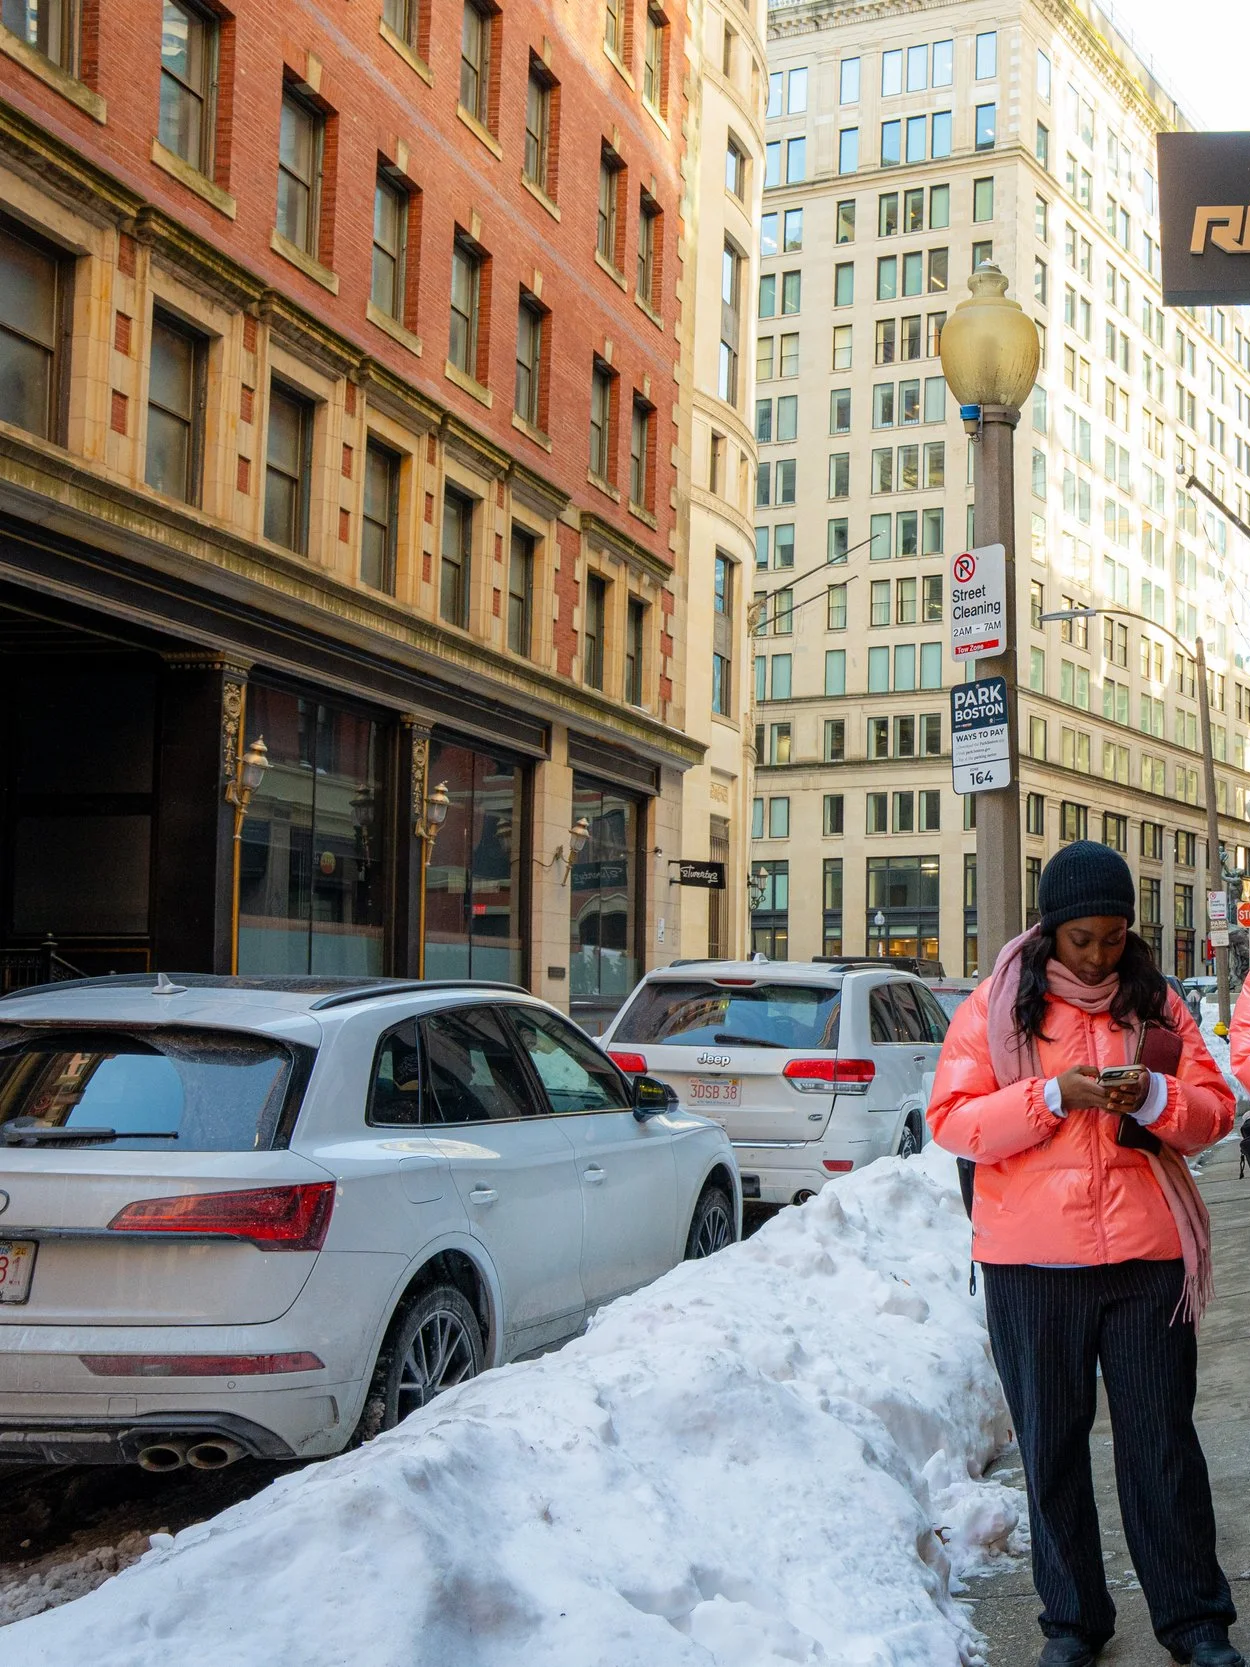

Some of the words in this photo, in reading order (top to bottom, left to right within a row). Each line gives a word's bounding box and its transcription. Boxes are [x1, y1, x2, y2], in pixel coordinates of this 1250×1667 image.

[952, 584, 986, 603] Street
[953, 601, 1001, 620] Cleaning
[953, 626, 972, 637] 2AM
[984, 620, 1002, 631] 7AM
[957, 646, 969, 654] Tow
[969, 644, 984, 652] Zone
[954, 684, 1002, 709] PARK
[955, 702, 1004, 722] BOSTON
[956, 733, 977, 742] WAYS
[978, 731, 989, 739] TO
[990, 728, 1004, 737] PAY
[970, 770, 993, 785] 164
[697, 1052, 731, 1067] Jeep
[690, 1084, 720, 1099] 3DSB
[723, 1086, 737, 1099] 38
